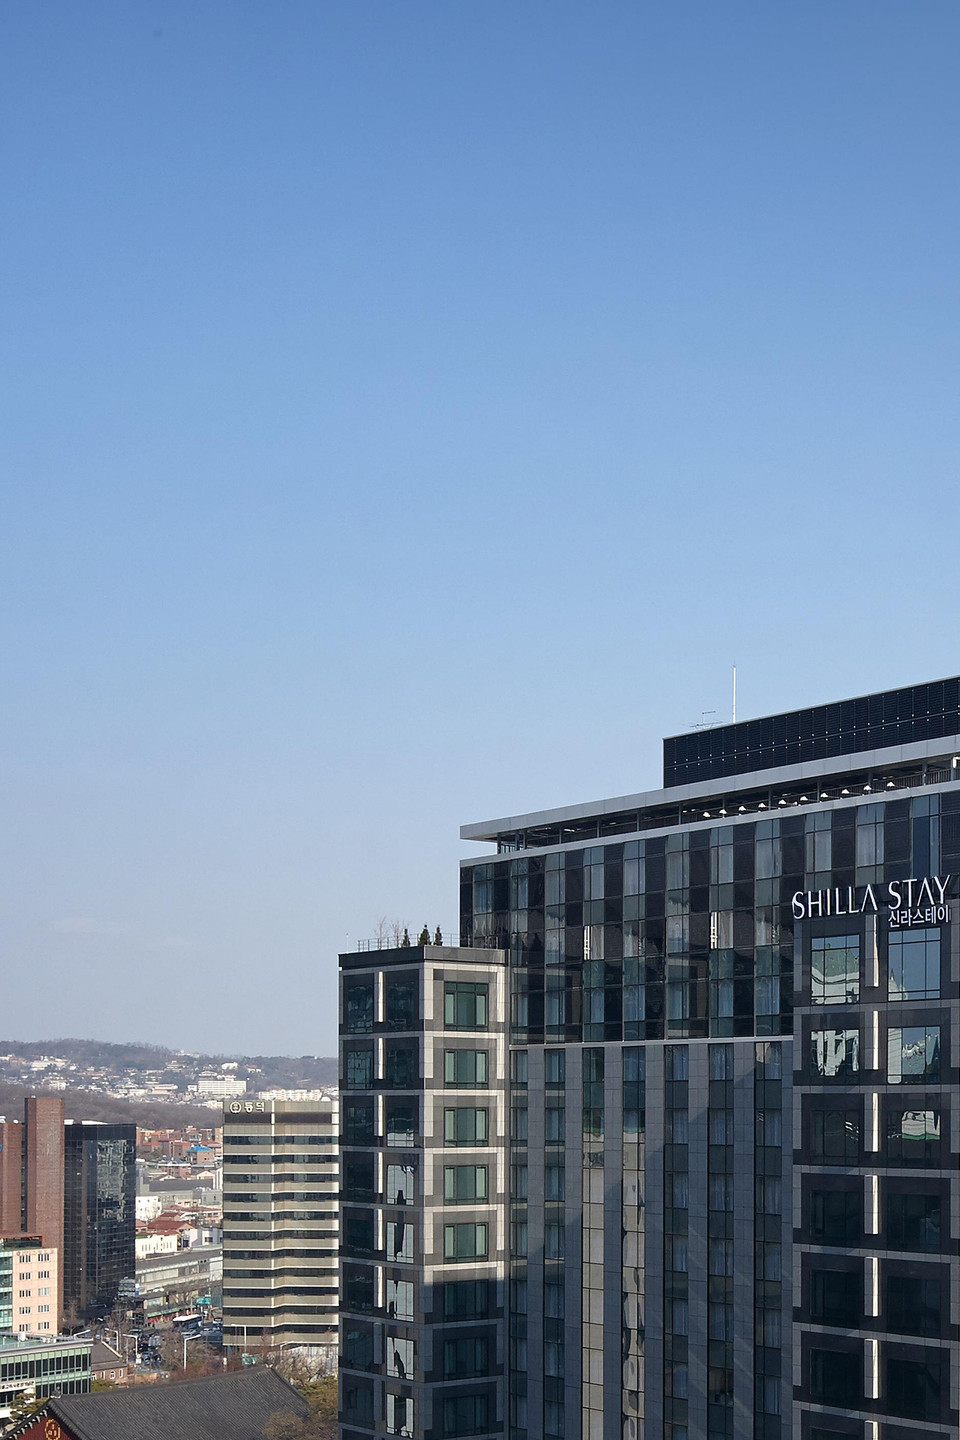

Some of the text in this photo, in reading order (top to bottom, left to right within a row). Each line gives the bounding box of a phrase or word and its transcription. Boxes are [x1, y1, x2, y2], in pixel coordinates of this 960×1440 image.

[792, 874, 951, 919] SHILLA STAY
[888, 904, 951, 928] 신라스테이
